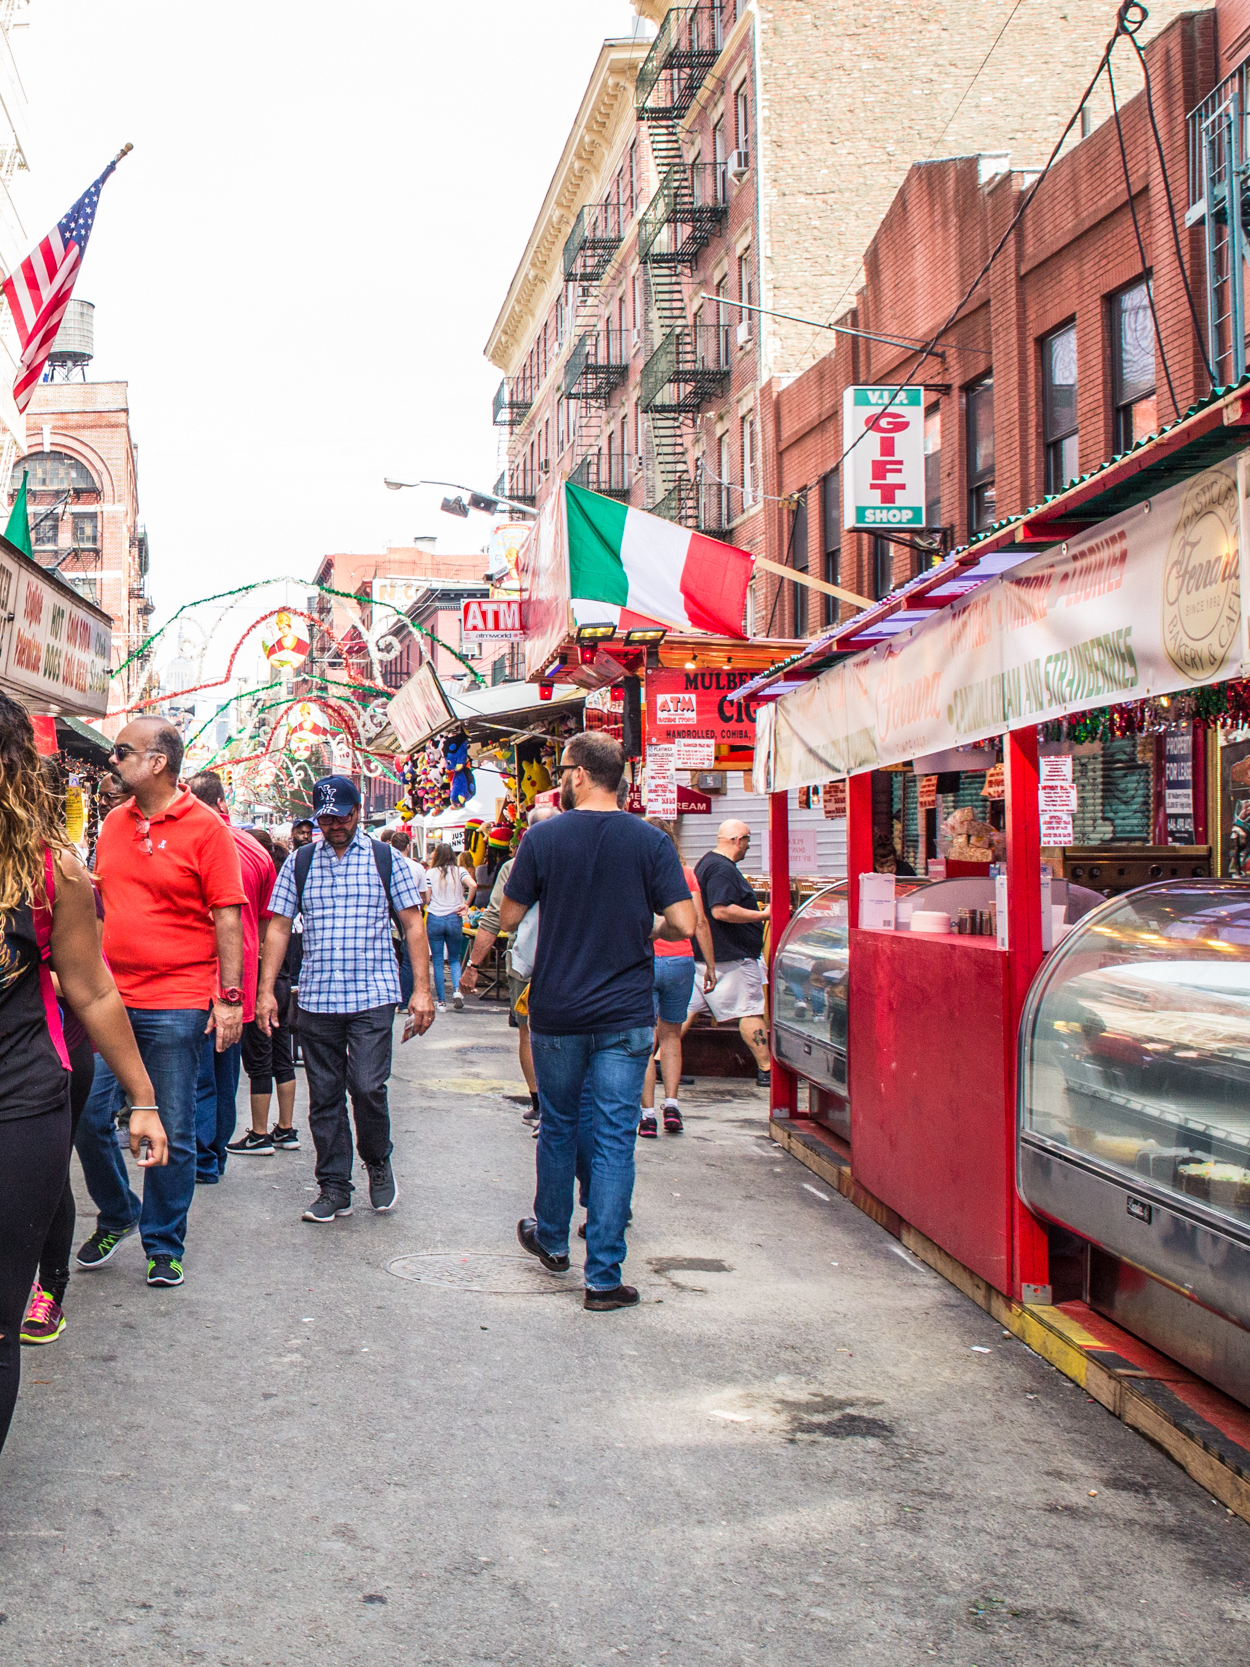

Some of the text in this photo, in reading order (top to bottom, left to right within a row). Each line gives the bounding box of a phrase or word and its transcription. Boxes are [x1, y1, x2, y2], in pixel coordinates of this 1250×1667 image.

[868, 391, 908, 404] V.I.P.
[864, 412, 910, 504] GIFT
[865, 509, 913, 522] SHOP
[50, 603, 64, 642] HOT
[465, 602, 519, 630] ATM
[1167, 614, 1205, 671] BAKERY
[1208, 643, 1217, 665] &
[1044, 626, 1138, 708] STRAWBERRIES
[658, 696, 694, 712] ATM
[1024, 658, 1044, 716] AND
